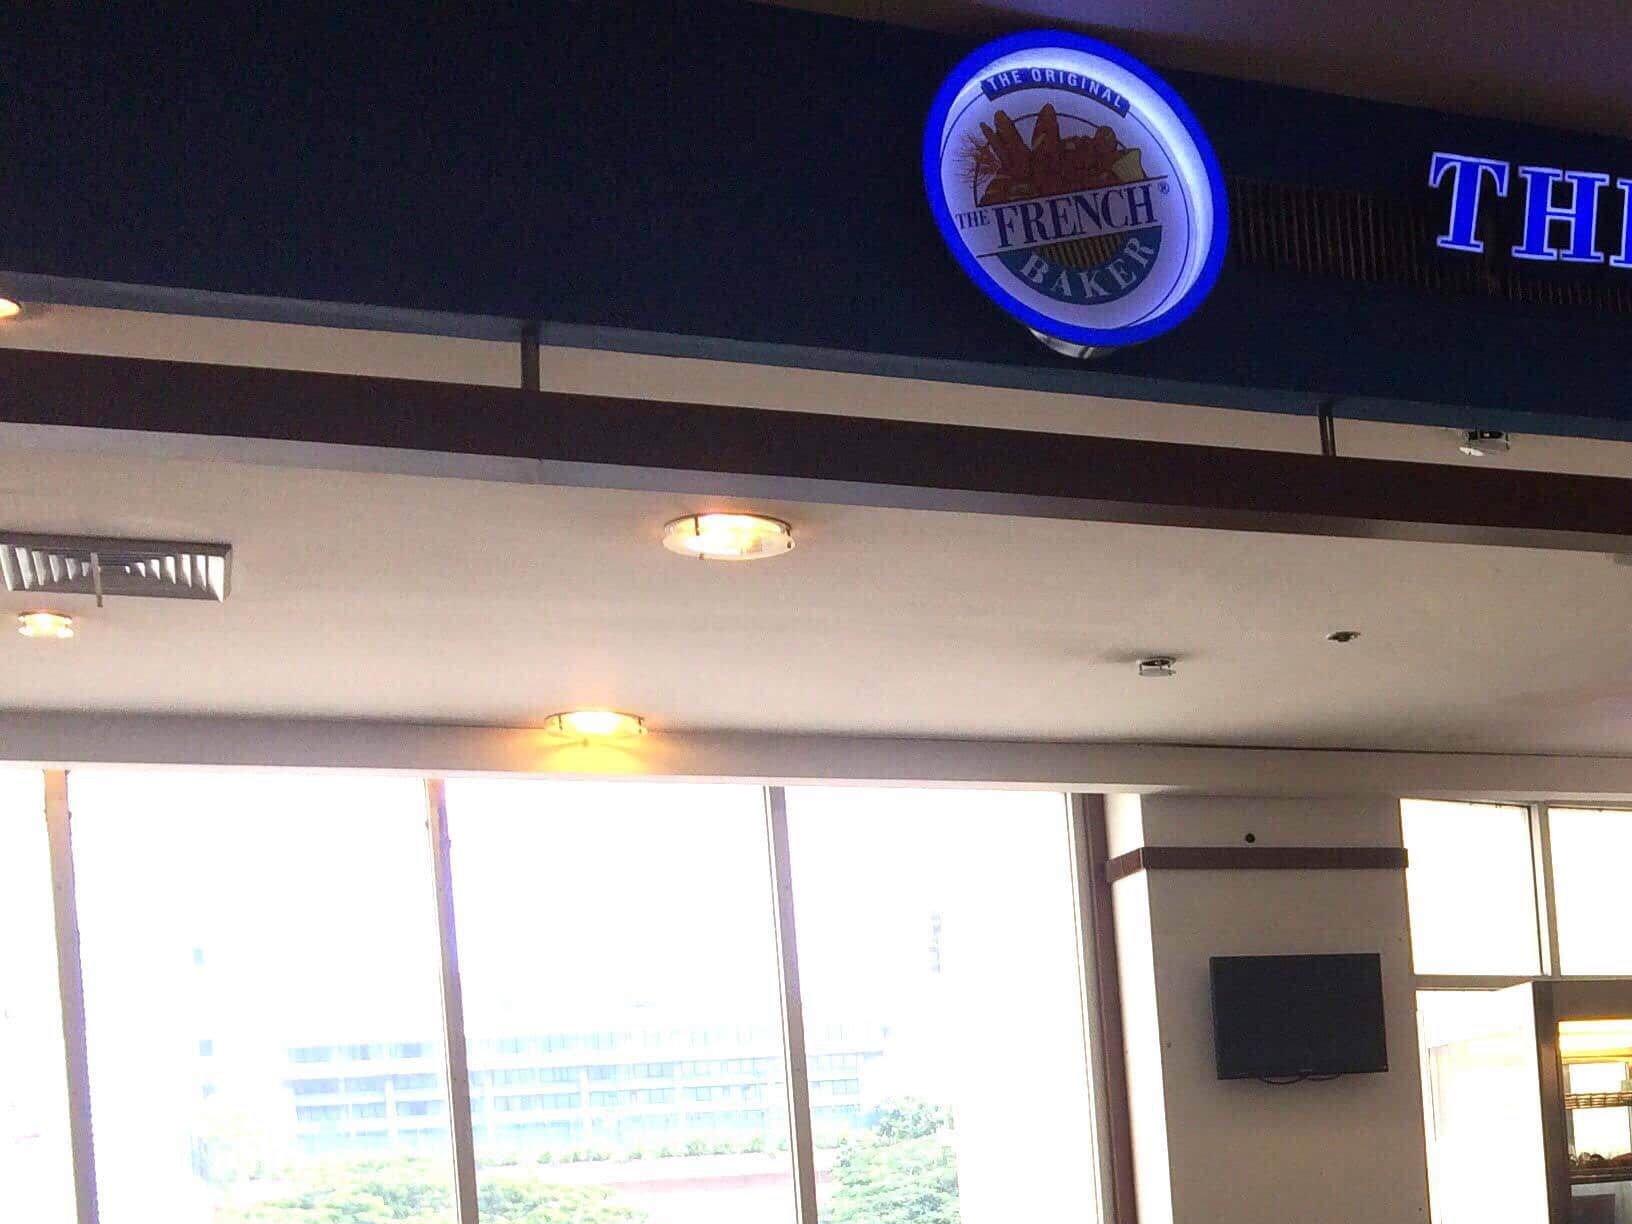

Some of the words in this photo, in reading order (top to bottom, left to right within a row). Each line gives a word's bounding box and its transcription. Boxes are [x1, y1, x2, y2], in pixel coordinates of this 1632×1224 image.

[986, 69, 1022, 92] THE
[1031, 68, 1122, 107] ORIGINAL
[955, 210, 991, 230] THE
[993, 182, 1158, 249] FRENCH
[1019, 236, 1155, 300] BAKER
